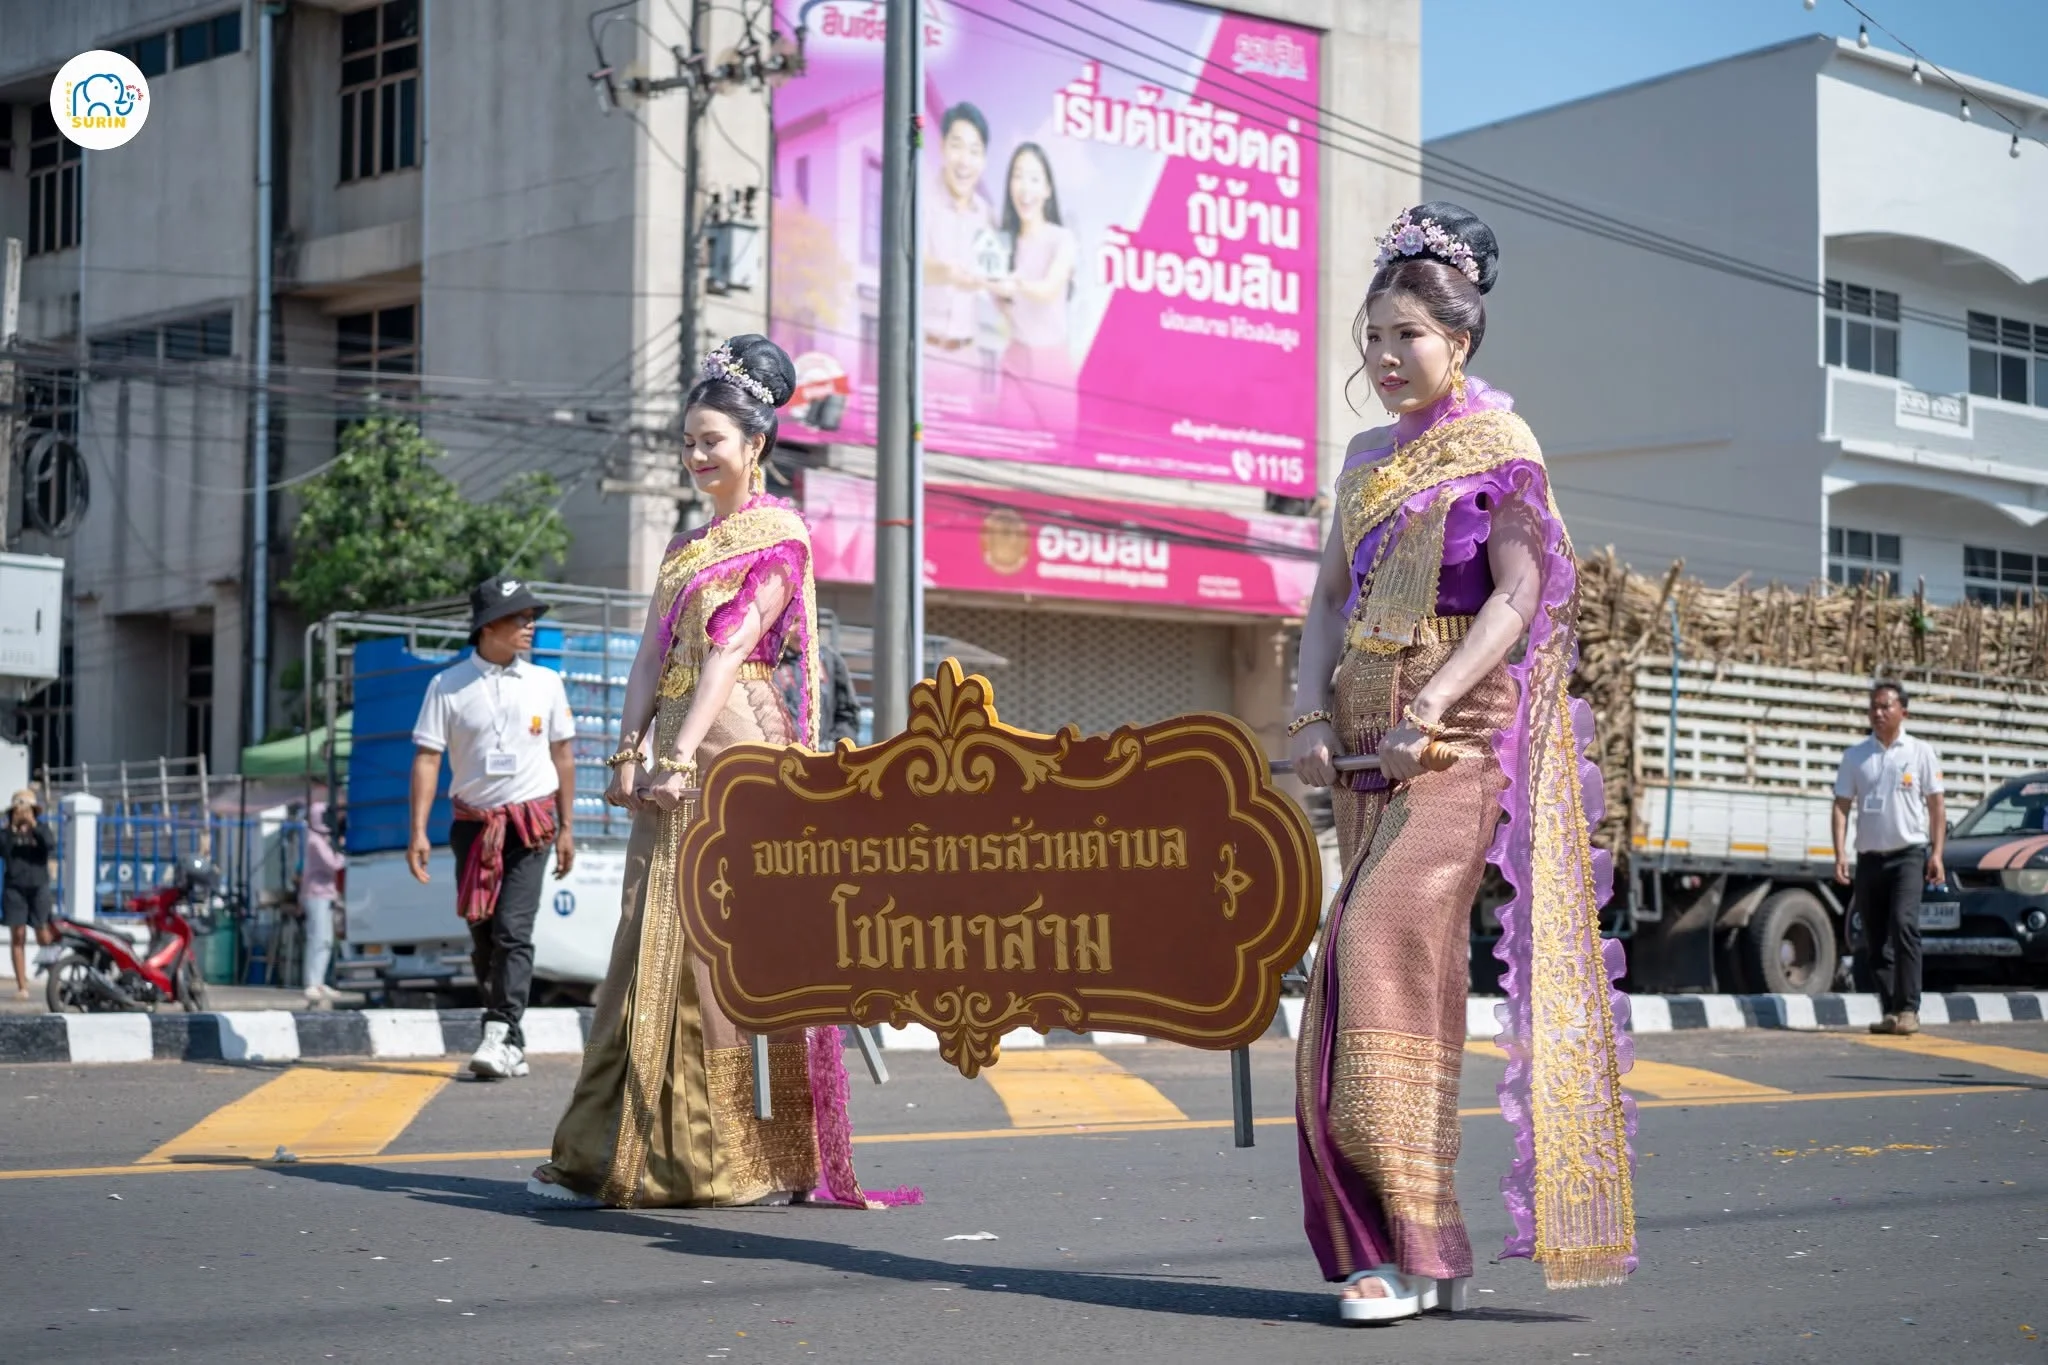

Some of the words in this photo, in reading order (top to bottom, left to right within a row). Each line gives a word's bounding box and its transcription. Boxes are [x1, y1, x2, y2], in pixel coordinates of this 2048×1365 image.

[1053, 62, 1300, 198] เริ่มต้นชีวิตคู่
[1187, 173, 1300, 257] กู้บ้าน
[1097, 228, 1300, 315] กับออมสิน
[1256, 453, 1304, 484] 1115
[750, 814, 1188, 877] องค์การบริหารส่วนตำบล
[829, 883, 1113, 972] โชคนาสาม
